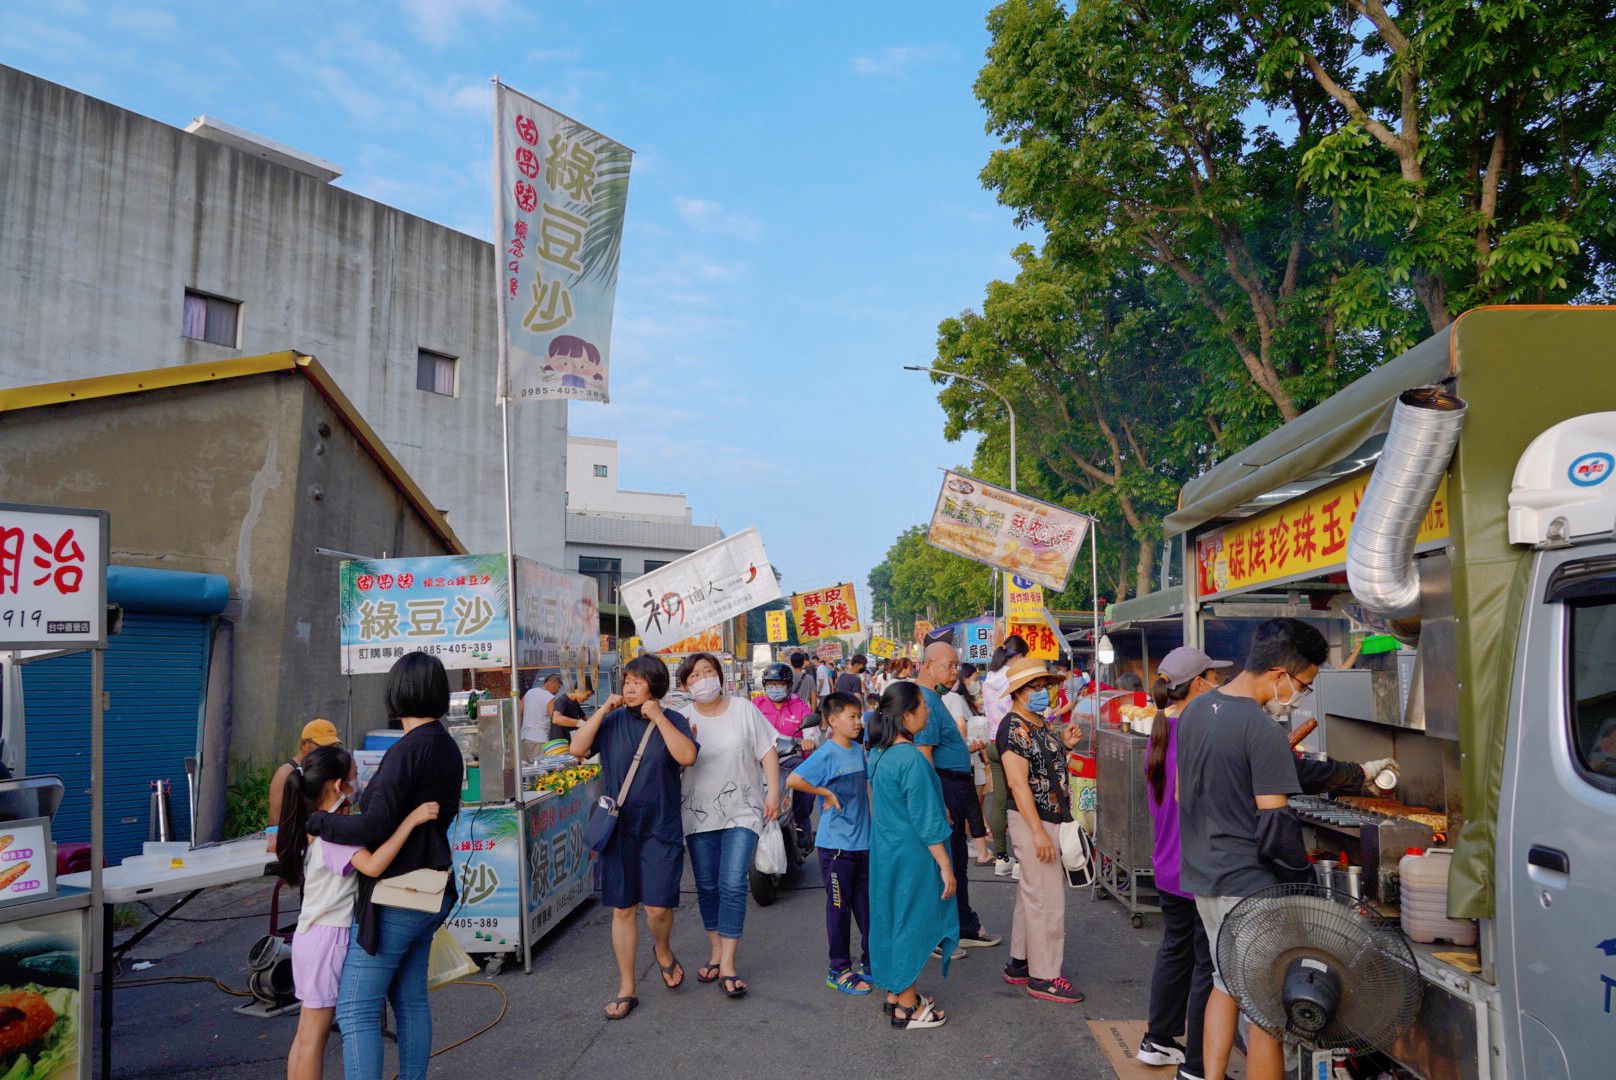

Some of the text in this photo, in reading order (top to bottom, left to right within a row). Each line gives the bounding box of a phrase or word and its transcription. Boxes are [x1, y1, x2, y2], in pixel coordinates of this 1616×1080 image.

[514, 113, 539, 212] 古早味
[522, 134, 596, 332] 綠豆沙
[521, 387, 606, 400] 0985-405-389
[357, 572, 492, 591] 古早味 懷念a綠豆沙
[803, 589, 842, 608] 酥皮
[48, 622, 89, 632] 台中直營店
[359, 596, 494, 641] 綠豆沙
[969, 644, 991, 659] 章魚
[532, 822, 584, 902] 綠豆沙
